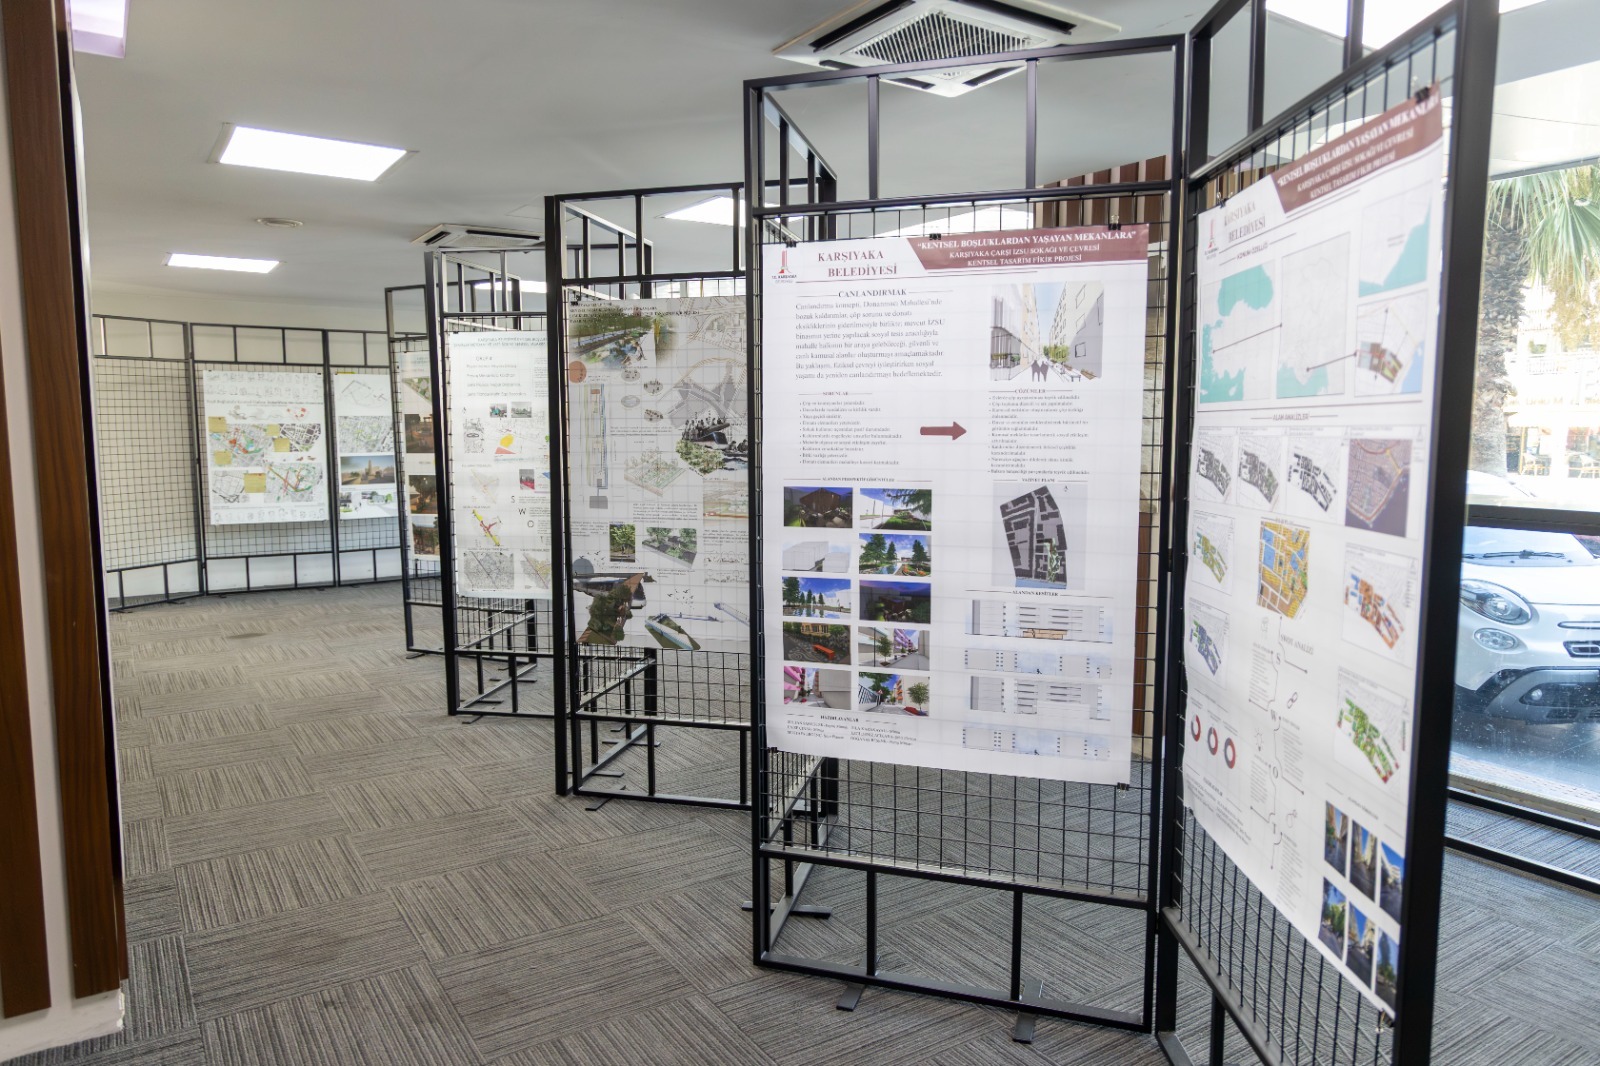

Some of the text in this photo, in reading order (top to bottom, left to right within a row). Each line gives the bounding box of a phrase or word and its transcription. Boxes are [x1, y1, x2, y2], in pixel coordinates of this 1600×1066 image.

[1228, 215, 1266, 243] BELEDİYESİ
[918, 231, 1137, 250] “KENTSEL BOŞLUKLARDAN YAŞAYAN MEKANLARA”
[818, 250, 884, 262] KARŞIYAKA
[949, 250, 989, 259] KARŞIYAKA
[990, 249, 1012, 257] ÇARŞI
[1029, 245, 1057, 255] SOKAĞI
[1059, 245, 1068, 253] VE
[1069, 243, 1100, 252] ÇEVRESİ
[967, 254, 1082, 267] KENTSEL TASARIM FİKİR PROJESİ
[827, 263, 898, 278] BELEDİYESİ
[838, 288, 907, 298] CANLANDIRMAK
[872, 331, 890, 339] sosyal
[916, 360, 934, 368] sosyal
[510, 495, 516, 504] S
[517, 507, 527, 515] W
[1276, 652, 1281, 665] S
